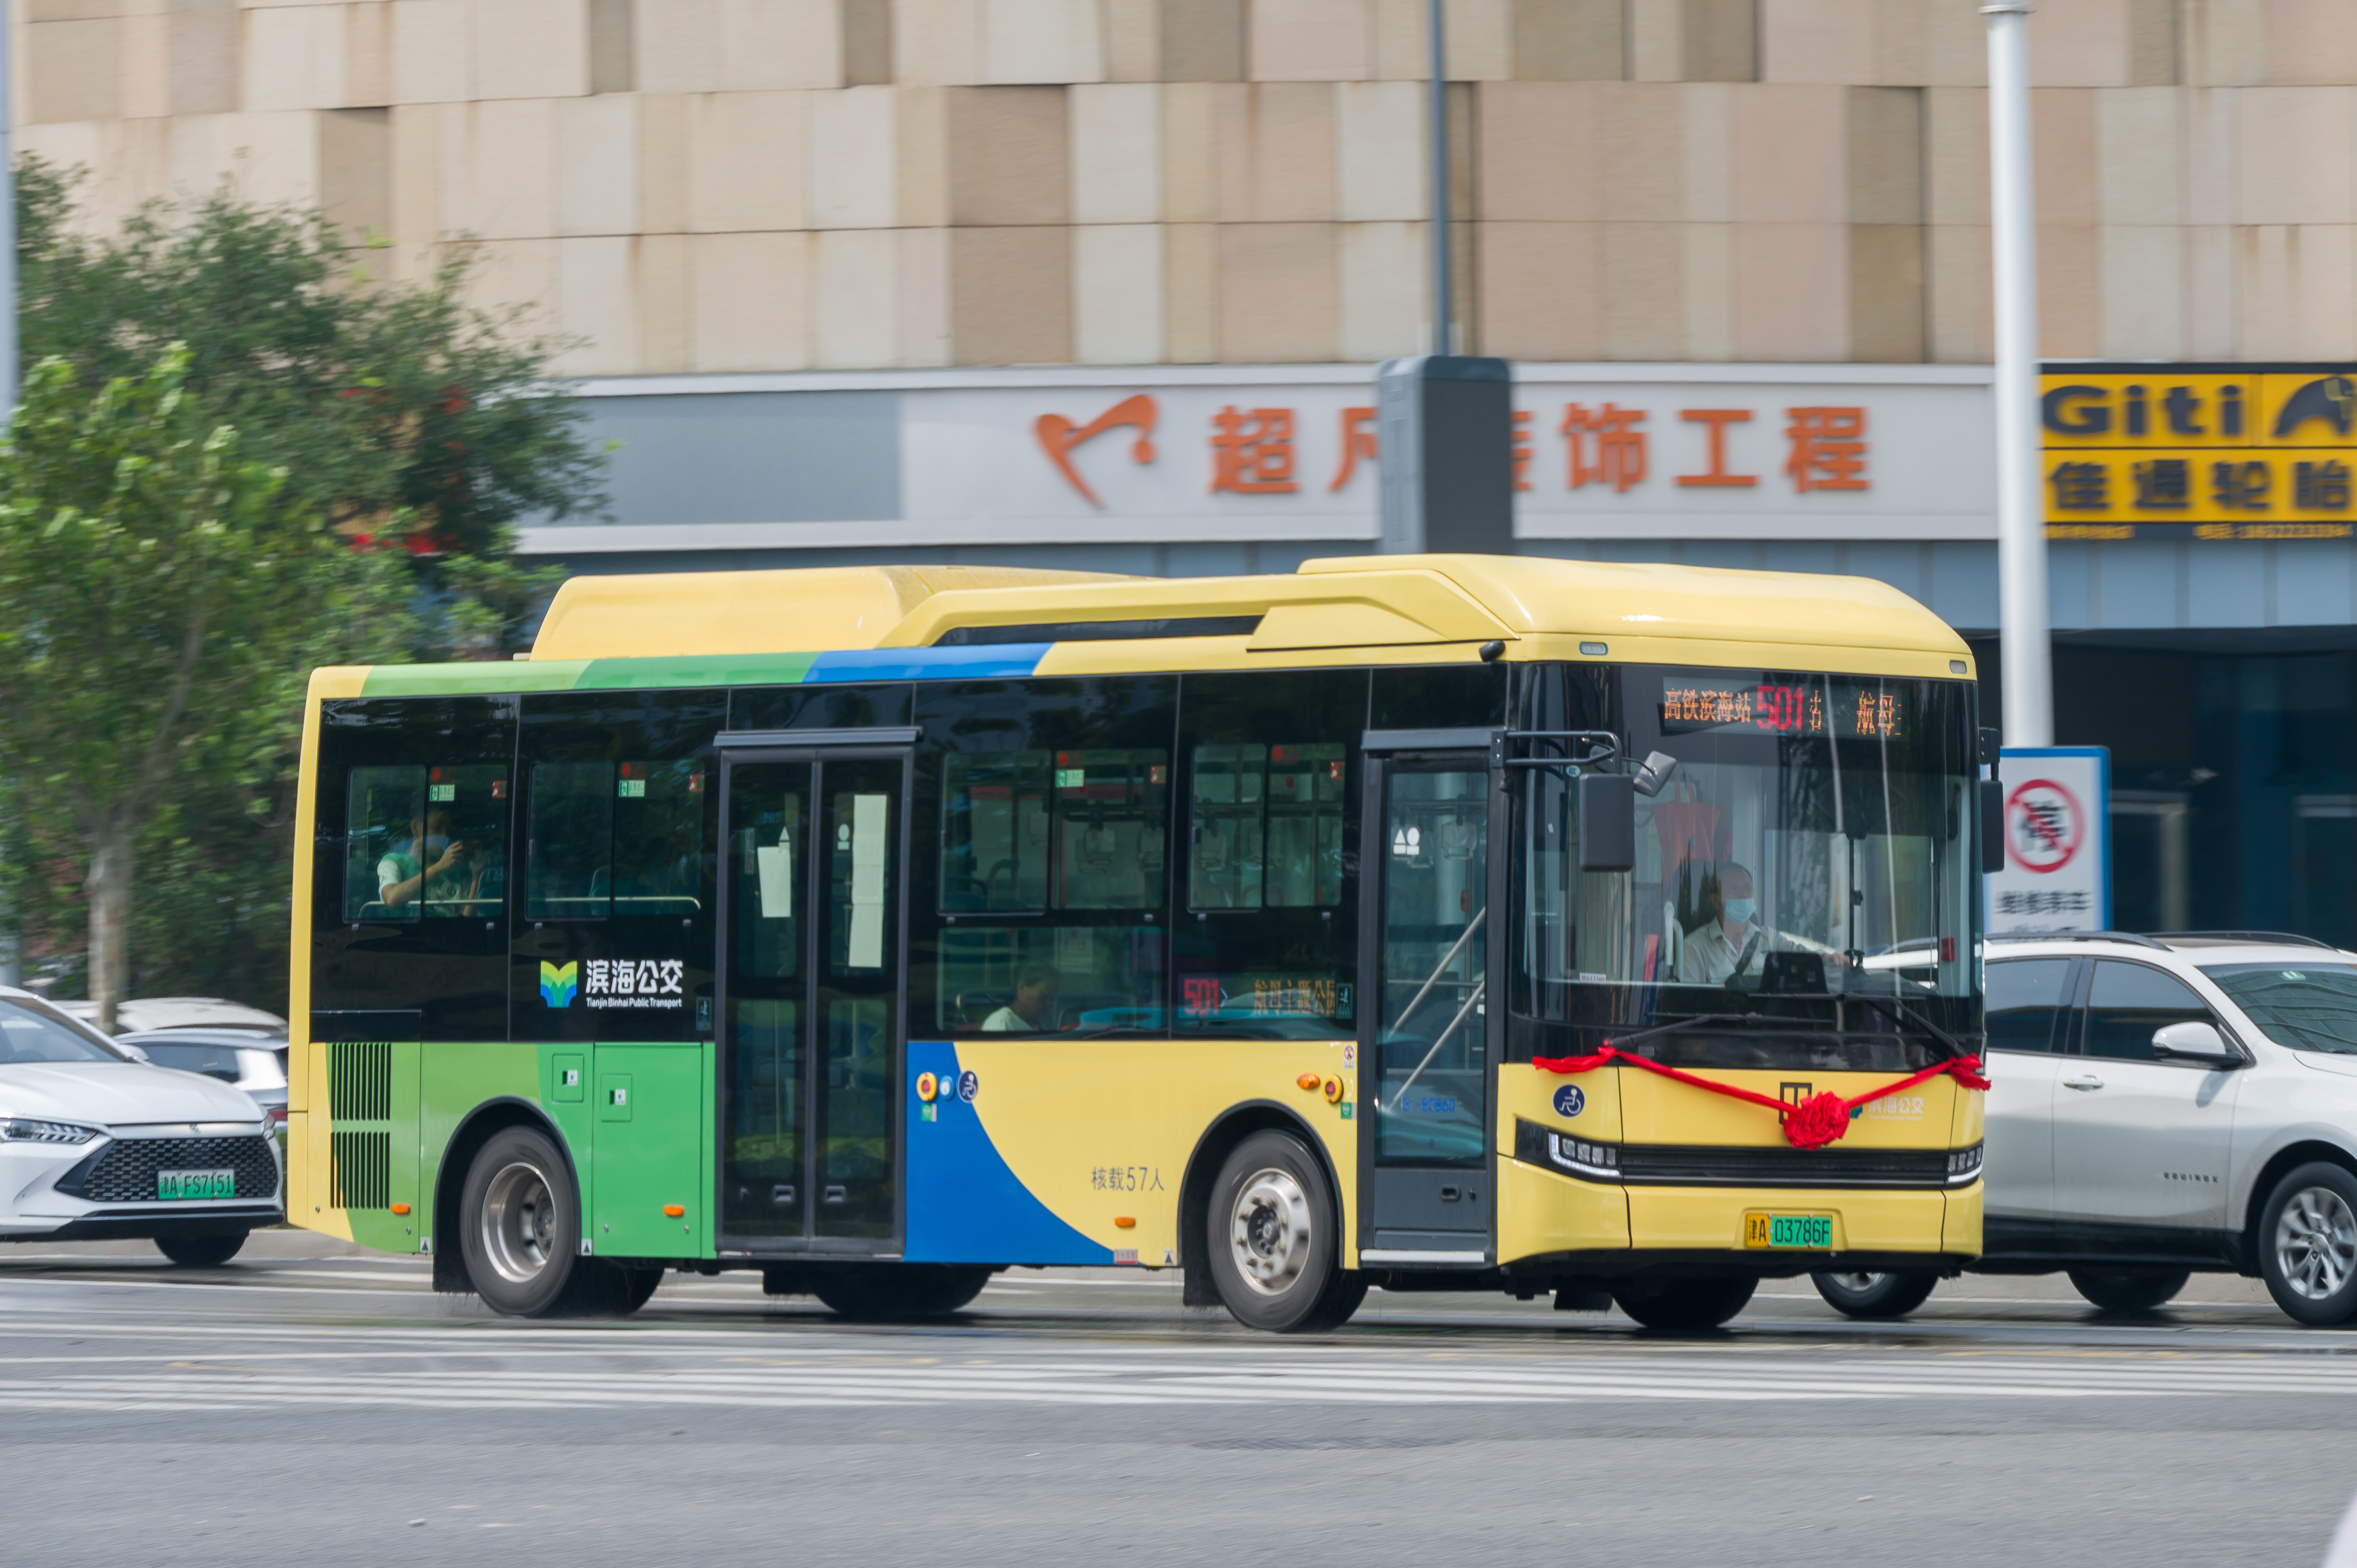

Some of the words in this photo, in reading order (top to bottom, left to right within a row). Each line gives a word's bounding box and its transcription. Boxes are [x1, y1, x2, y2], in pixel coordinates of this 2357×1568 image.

[2042, 385, 2245, 436] Giti
[1207, 403, 1874, 494] 超饰工程
[1756, 686, 1803, 730] 501
[1856, 690, 1902, 736] 航母
[585, 959, 683, 994] 滨海公交
[586, 997, 608, 1009] Tianjin
[629, 997, 650, 1008] Public
[649, 997, 682, 1009] Transport
[1184, 979, 1219, 1015] 501
[1091, 1166, 1164, 1192] 核载57人
